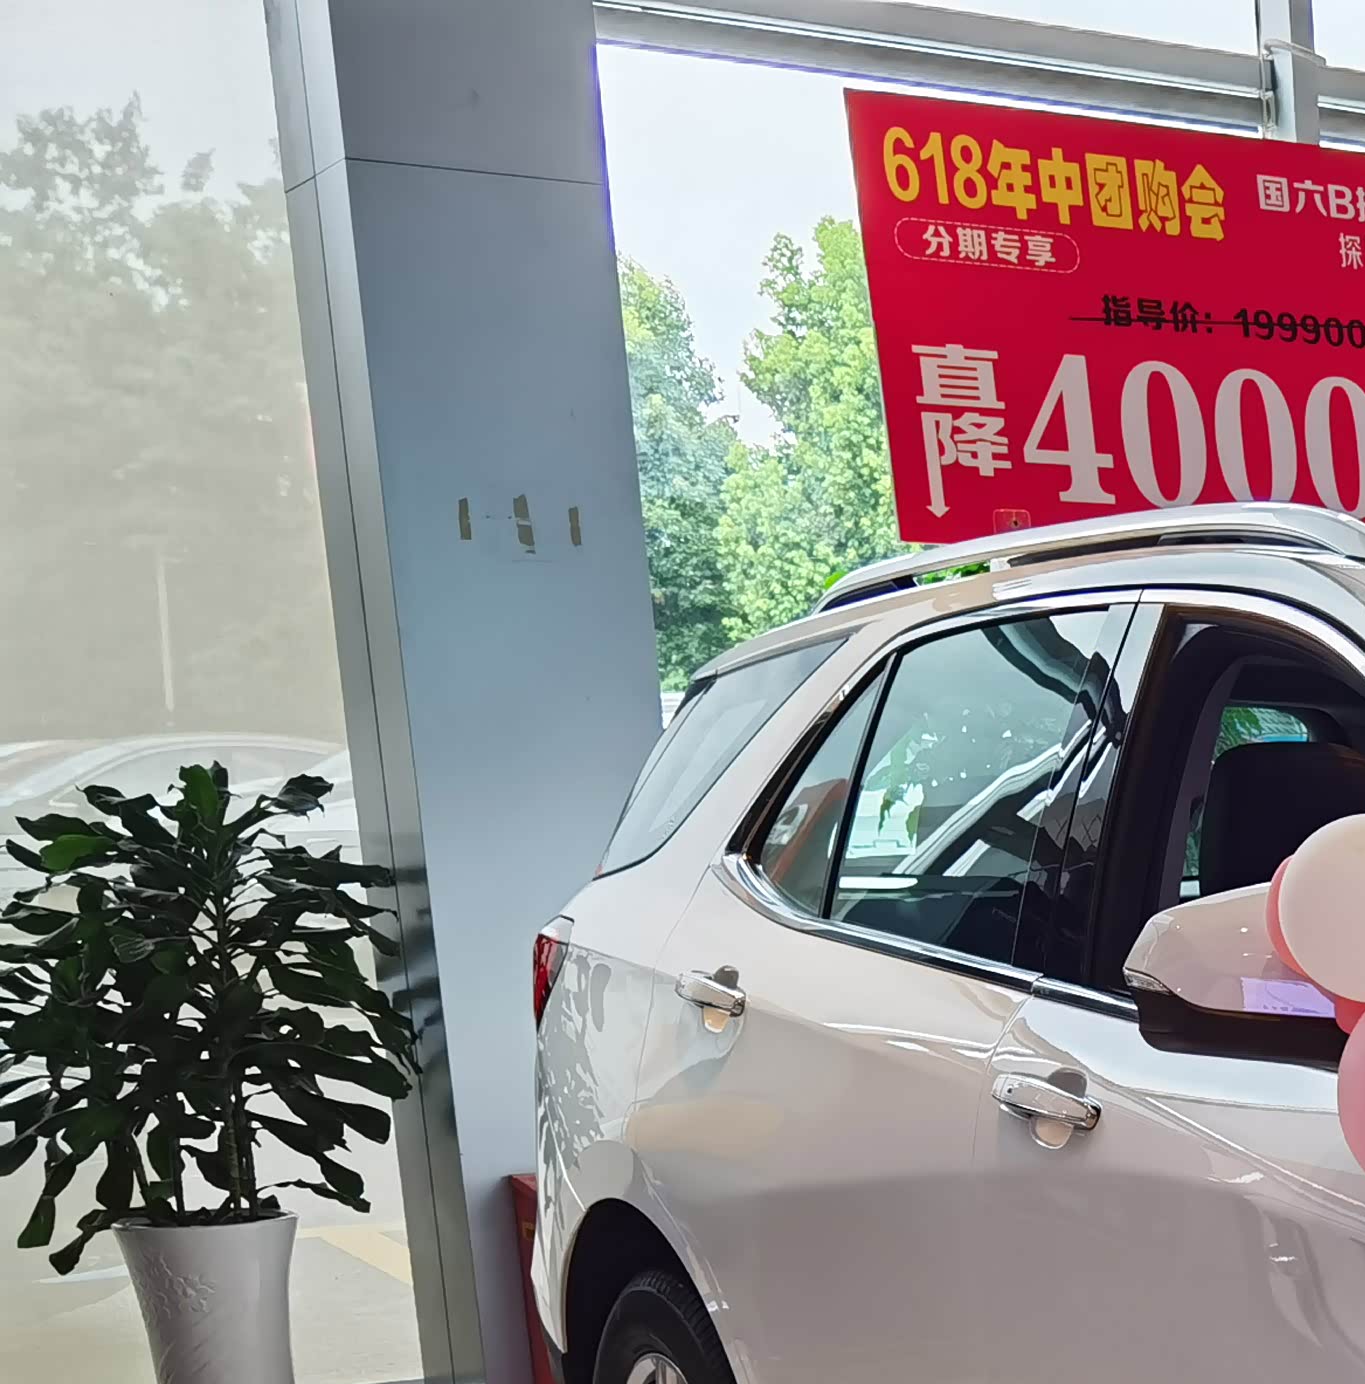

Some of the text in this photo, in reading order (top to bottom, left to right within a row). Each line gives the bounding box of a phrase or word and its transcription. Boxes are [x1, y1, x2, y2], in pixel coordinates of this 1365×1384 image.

[882, 125, 1226, 242] 618年中团购会
[921, 225, 1057, 268] 分期专享
[911, 343, 1013, 479] 直降
